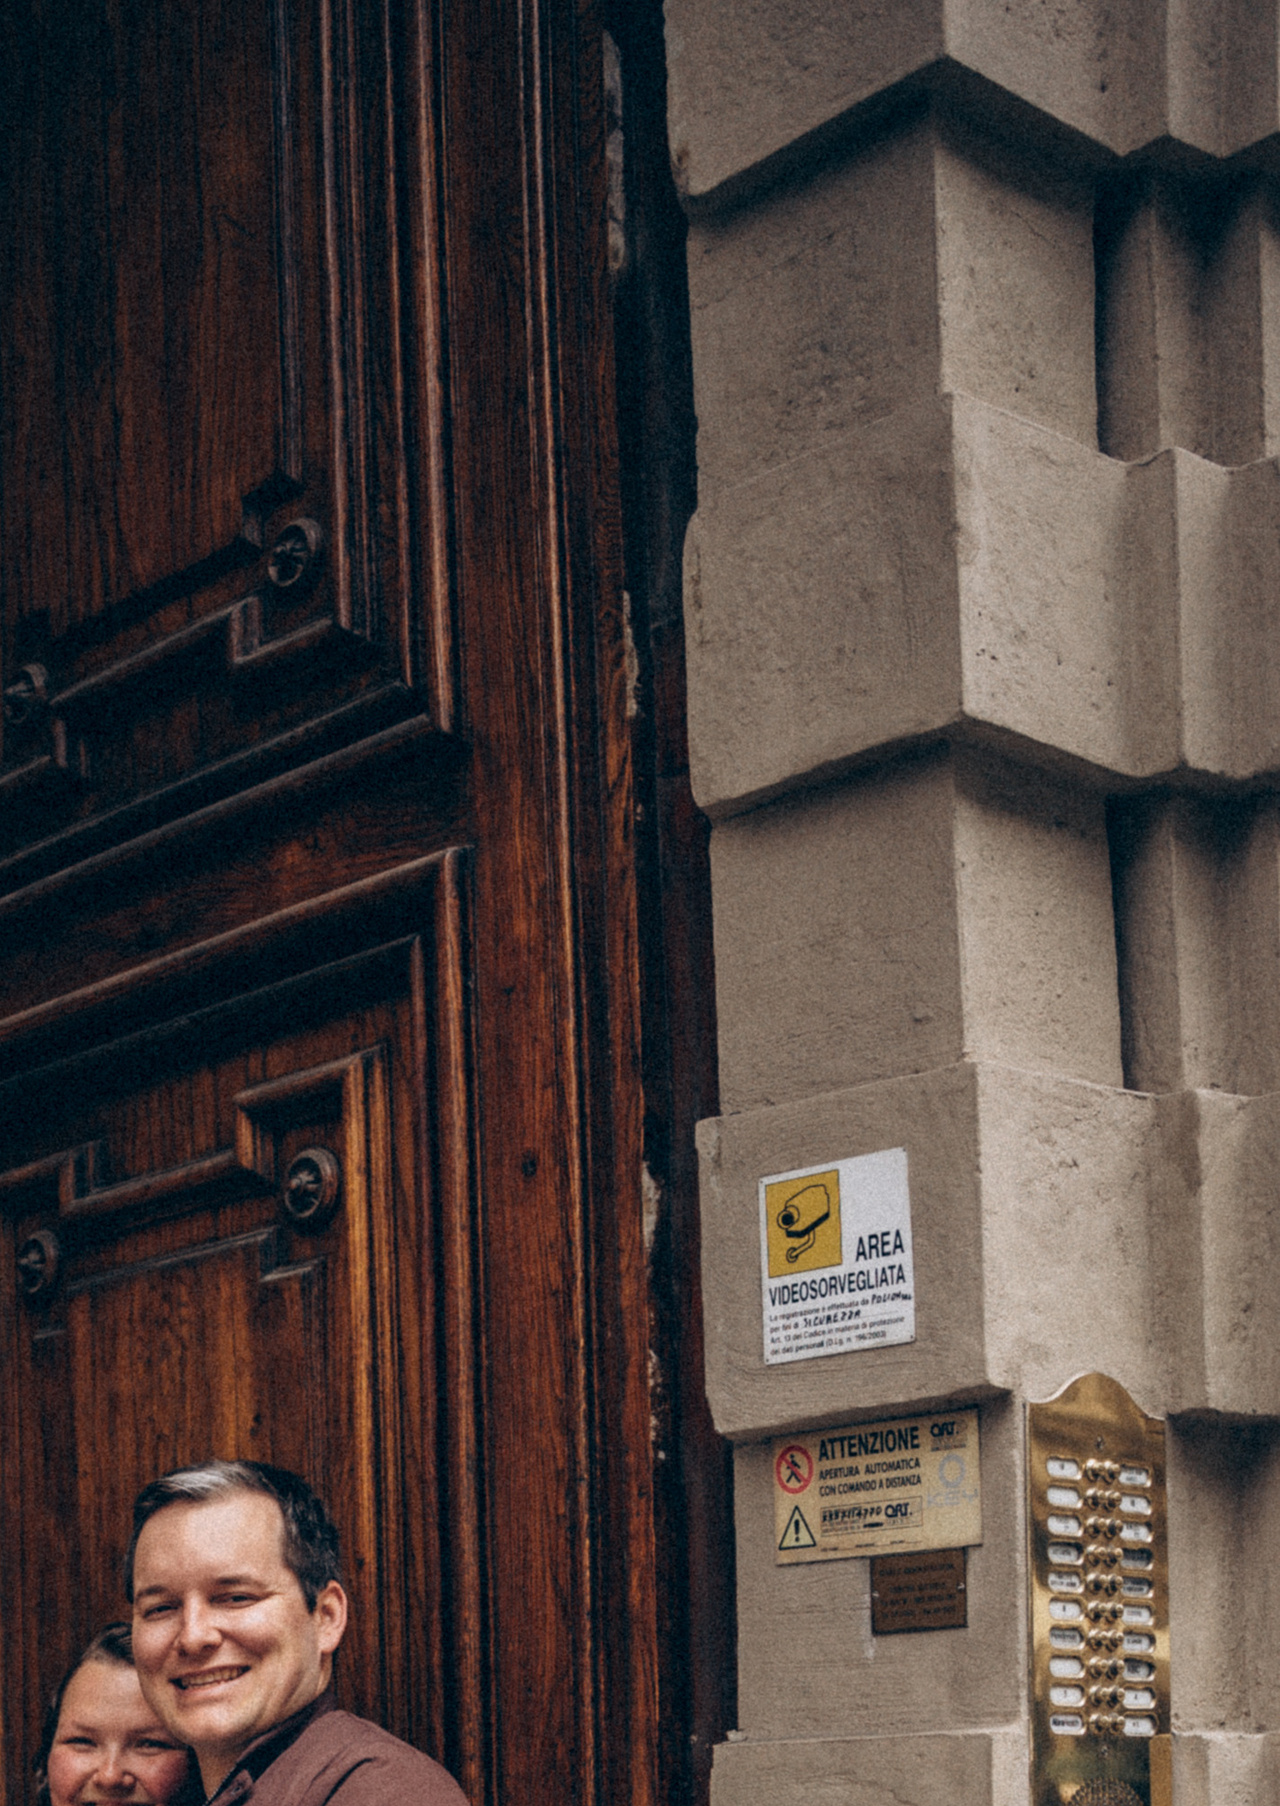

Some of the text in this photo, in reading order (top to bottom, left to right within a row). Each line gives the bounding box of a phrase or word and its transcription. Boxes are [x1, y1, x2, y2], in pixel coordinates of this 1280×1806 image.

[855, 1228, 905, 1262] AREA
[769, 1263, 906, 1307] VIDEOSORVEGLIATA
[803, 1309, 861, 1327] SICUREZZA
[818, 1425, 921, 1461] ATTENZIONE
[819, 1457, 921, 1480] APERTURA AUTOMATICA
[819, 1474, 922, 1497] CON COMANDO A DISTANZA
